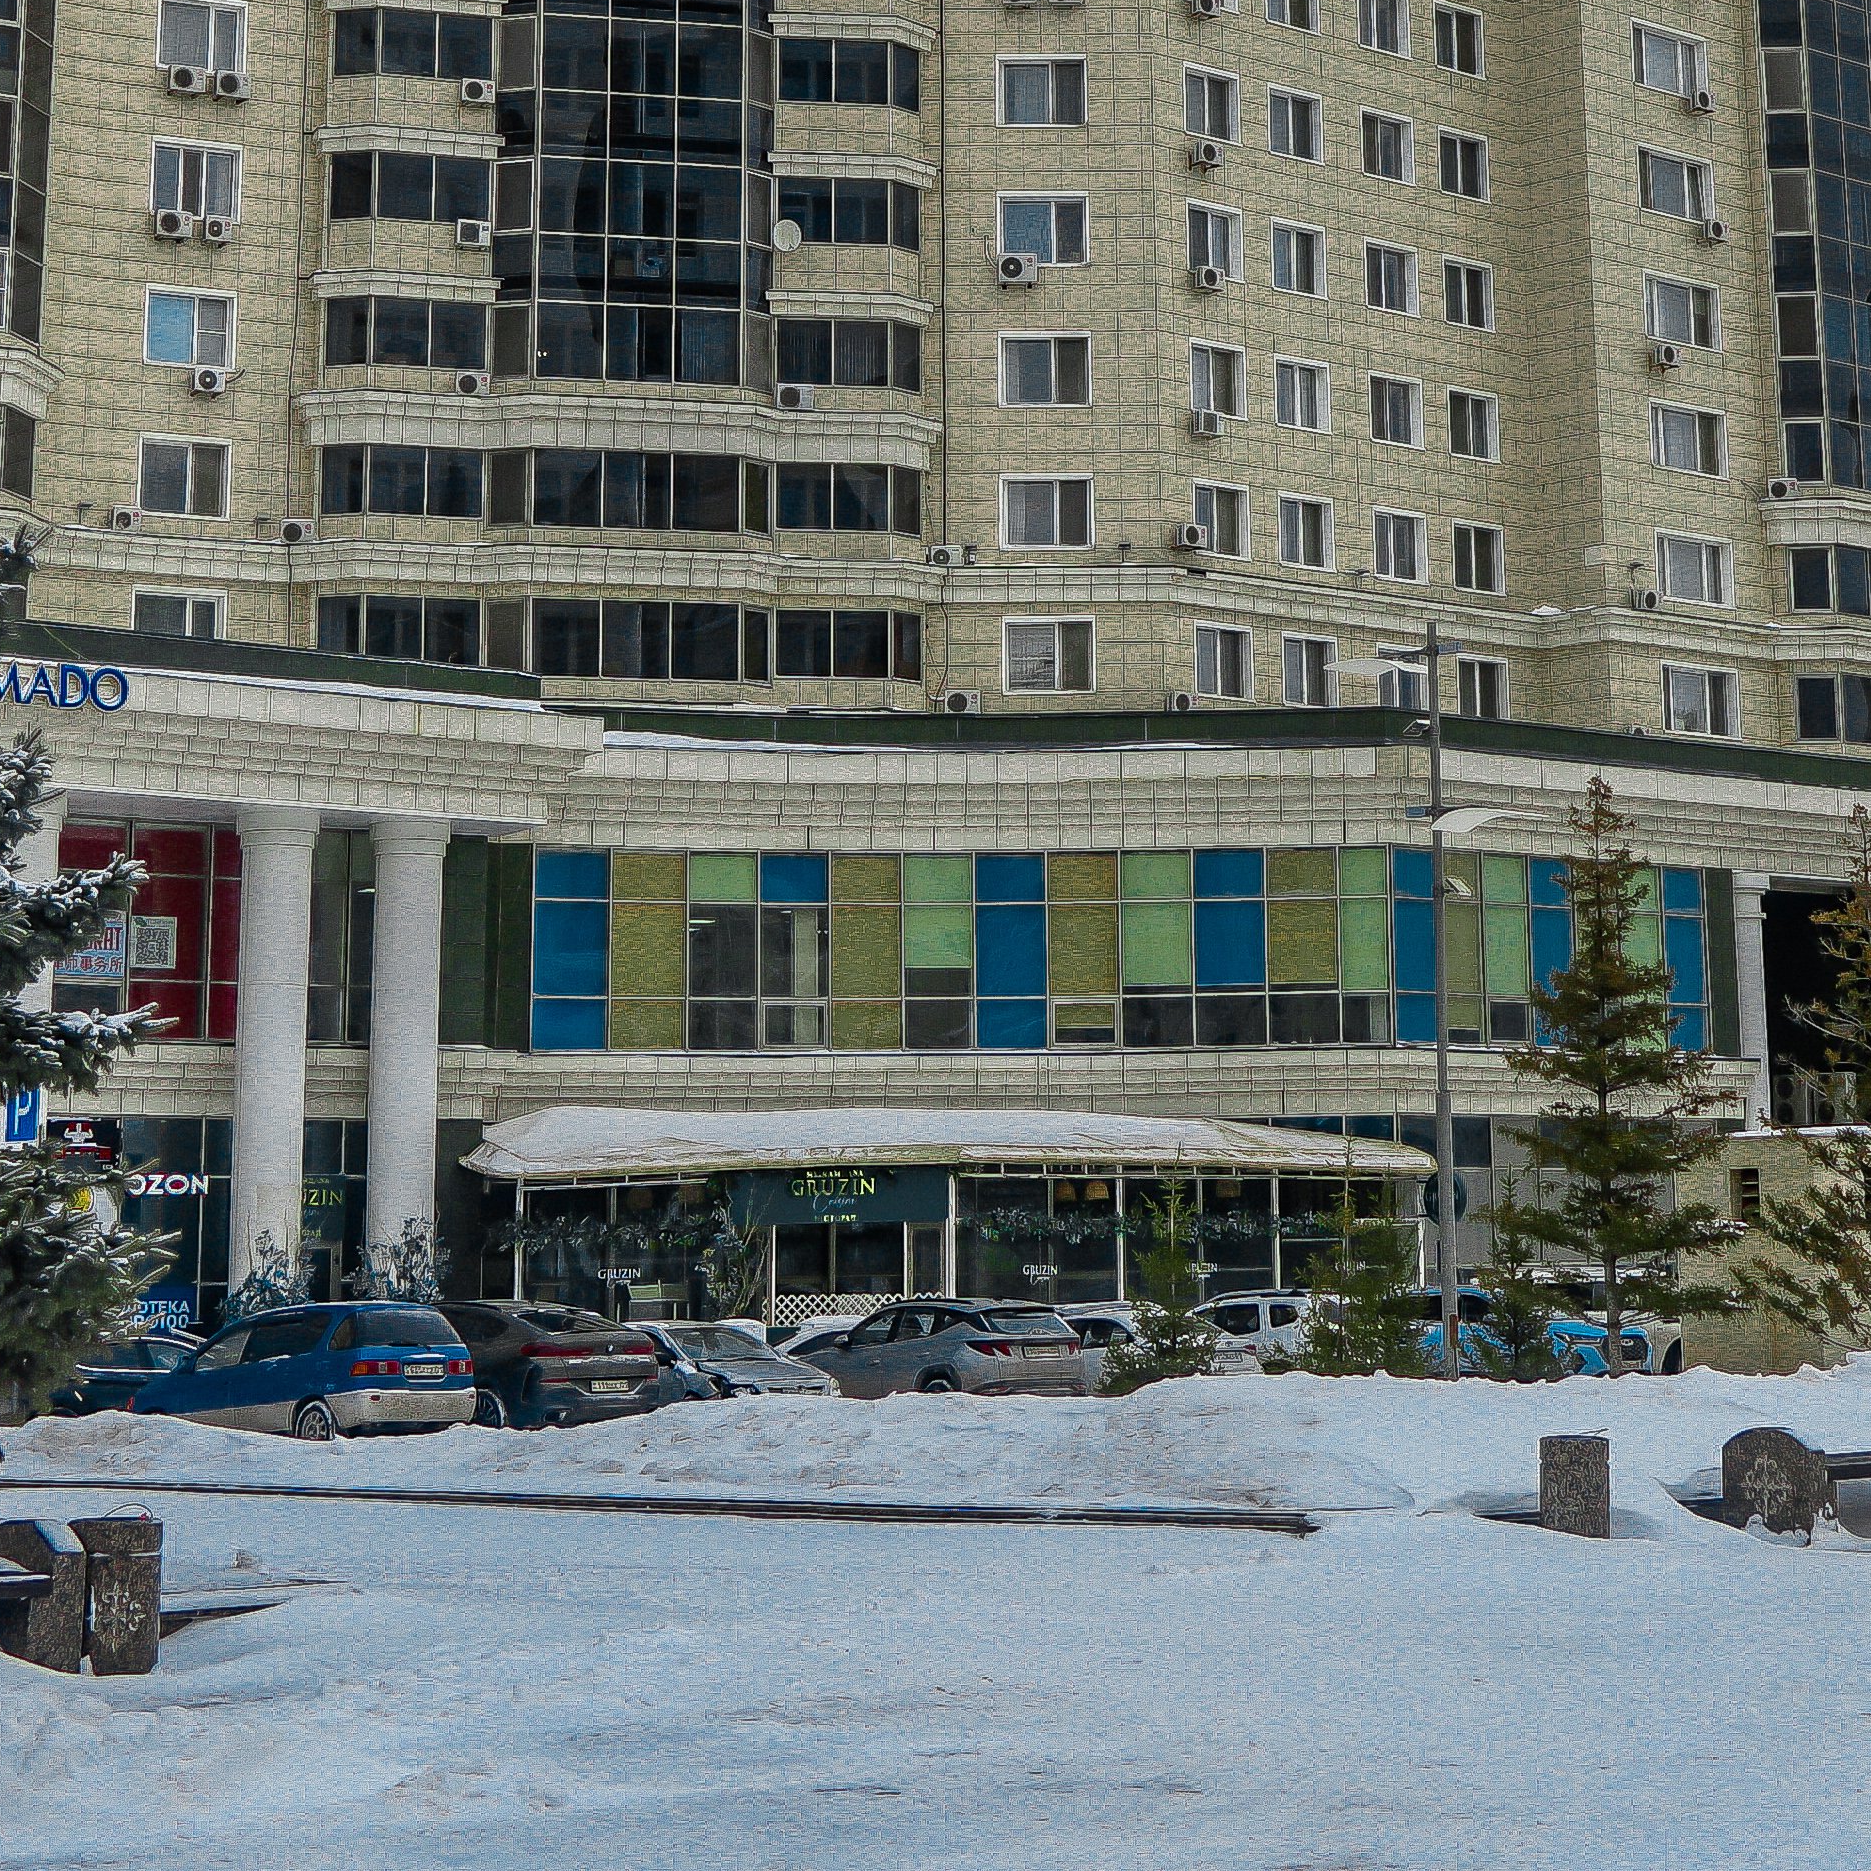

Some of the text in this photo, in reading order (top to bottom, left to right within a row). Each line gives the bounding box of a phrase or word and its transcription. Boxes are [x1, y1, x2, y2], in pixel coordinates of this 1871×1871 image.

[129, 1173, 209, 1196] OZON
[791, 1177, 876, 1196] GRUZIN
[302, 1189, 344, 1206] ZIN
[597, 1268, 641, 1279] GRUZIN
[1022, 1264, 1059, 1276] GRUZIN
